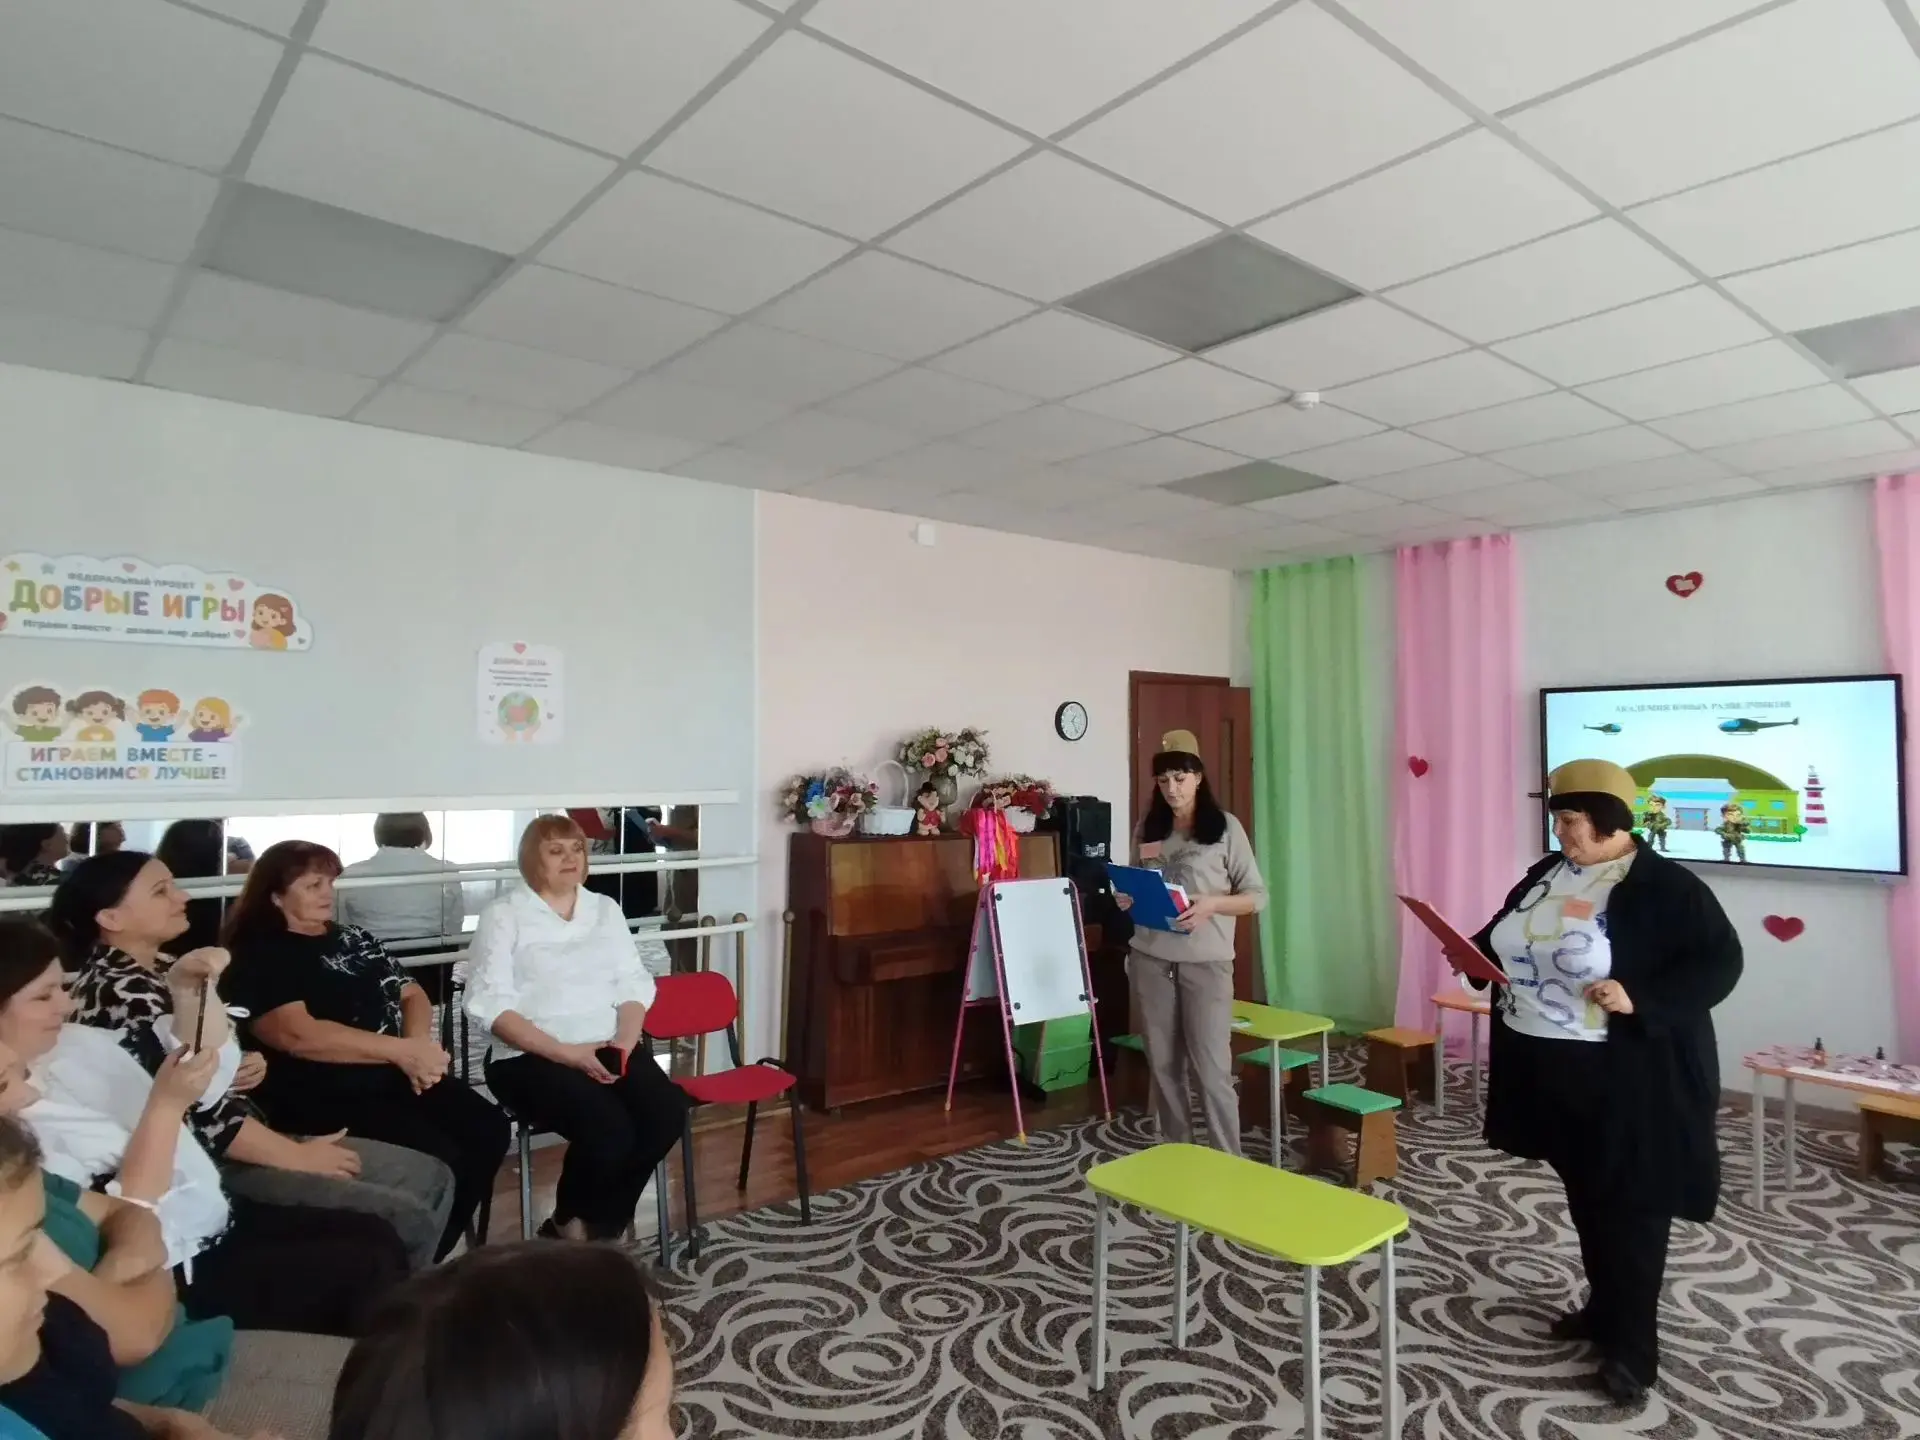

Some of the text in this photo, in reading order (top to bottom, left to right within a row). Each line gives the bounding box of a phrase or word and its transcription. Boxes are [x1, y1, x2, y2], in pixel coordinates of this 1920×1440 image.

[154, 579, 195, 589] ПРОЕКТ
[9, 579, 245, 622] ДОБРЫЕ ИГРЫ
[30, 747, 117, 762] ИГРАЕМ
[127, 747, 203, 762] ВМЕСТЕ
[16, 766, 226, 782] СТАНОВИМСЯ ЛУЧШЕ!
